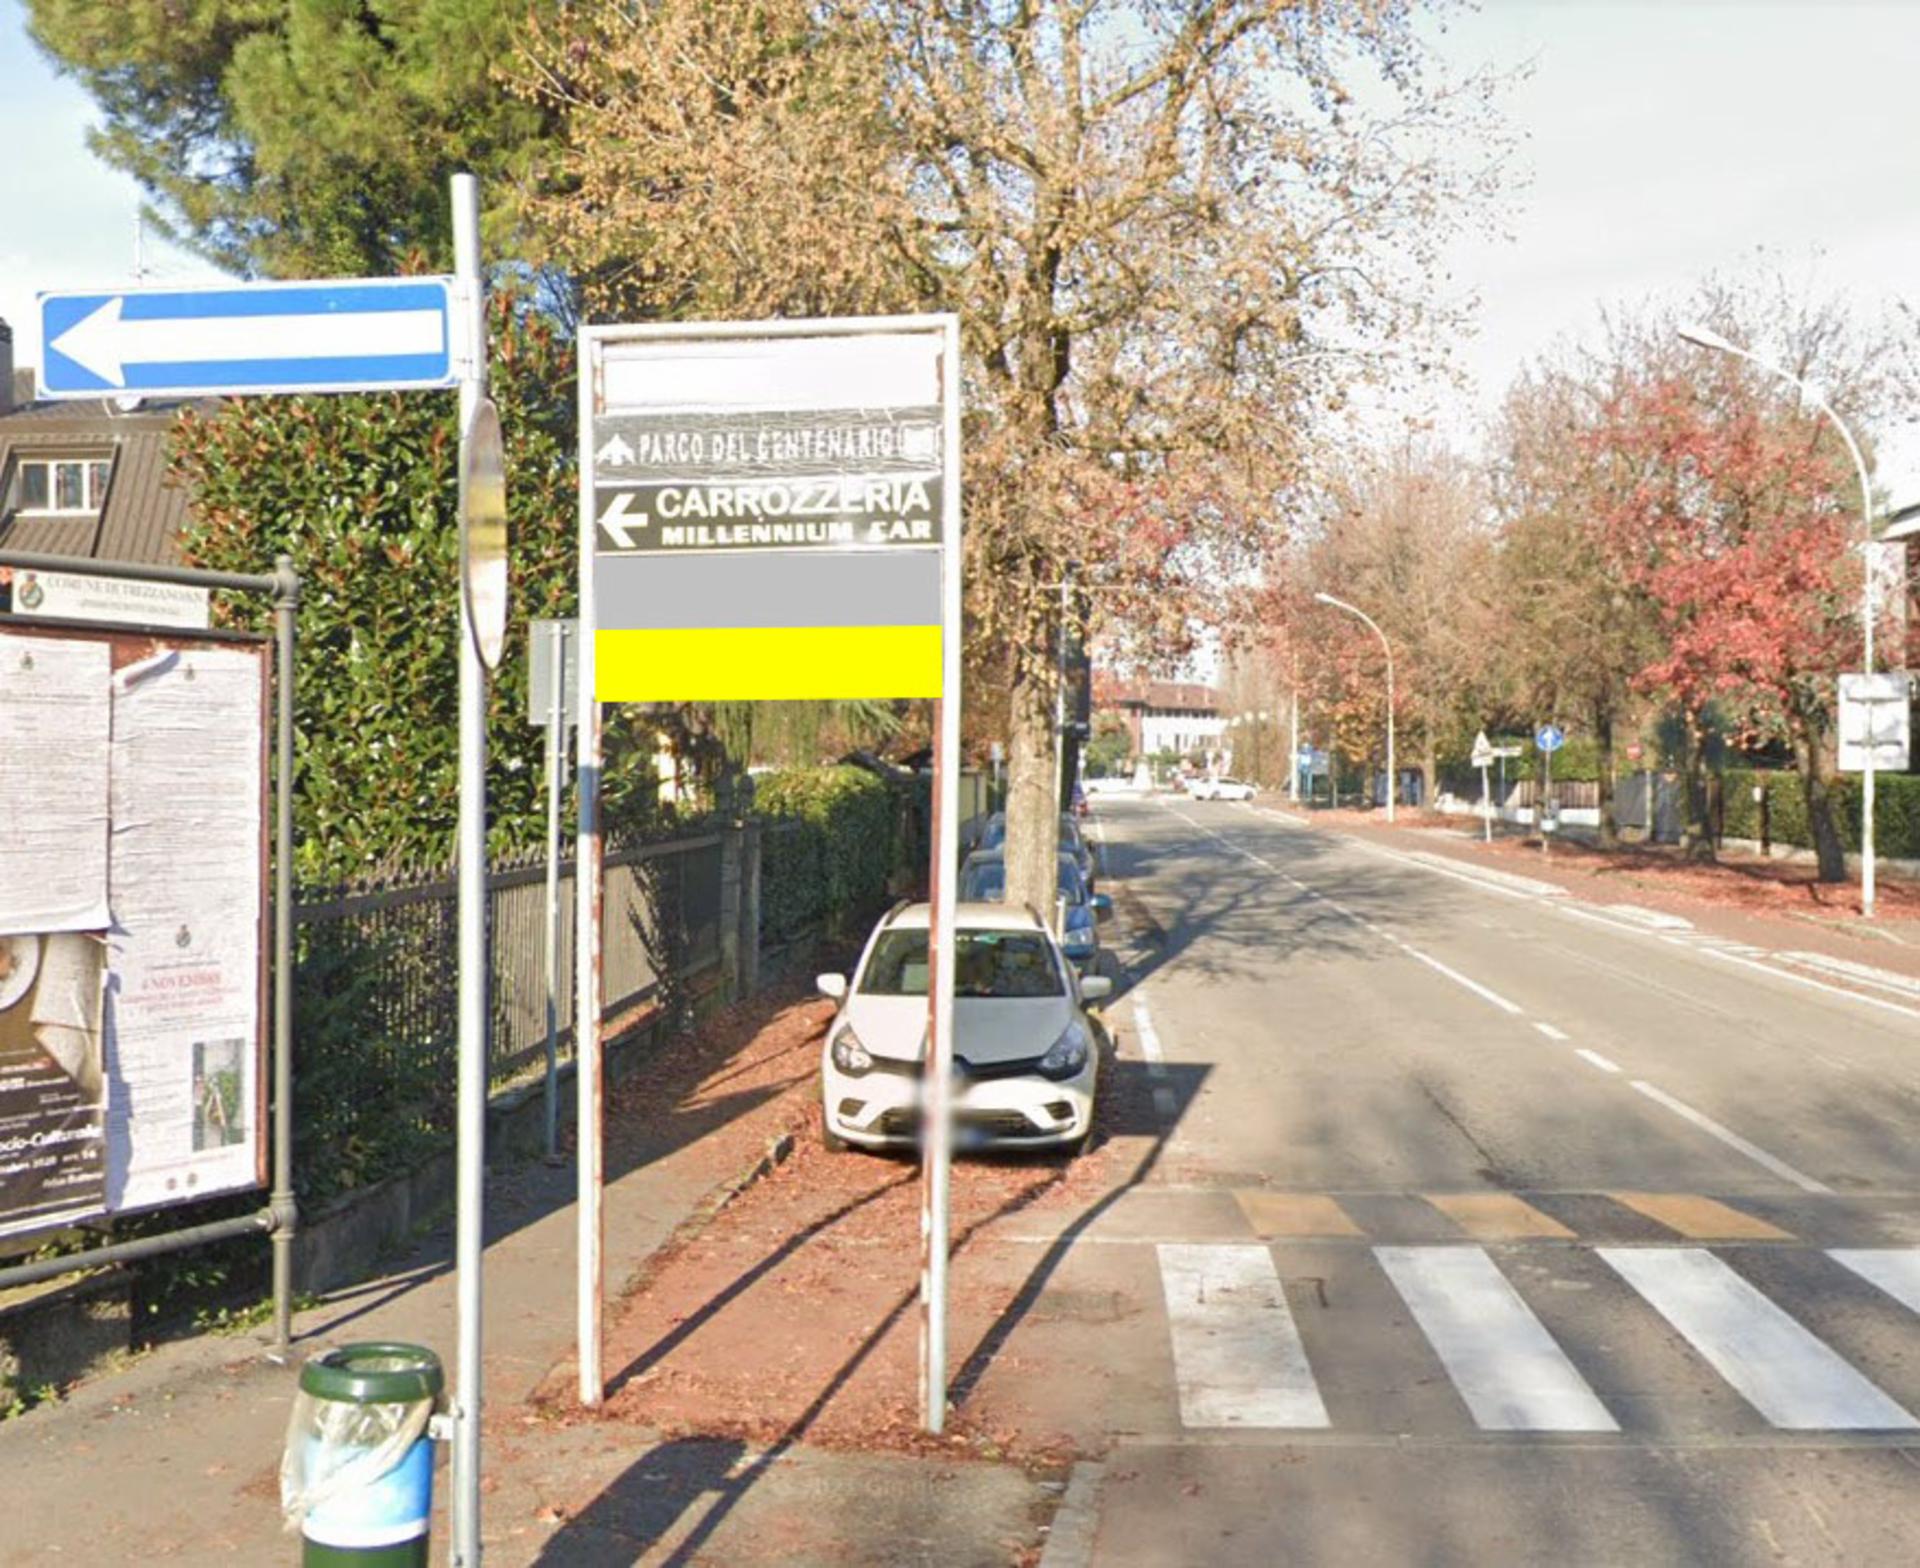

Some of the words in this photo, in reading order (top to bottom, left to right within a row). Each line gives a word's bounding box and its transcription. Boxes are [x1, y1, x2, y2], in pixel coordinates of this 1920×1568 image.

[639, 432, 704, 464] PARCO
[711, 432, 749, 462] DEL
[757, 427, 892, 463] CENTENARIO
[656, 480, 932, 519] CARROZZERIA
[661, 521, 854, 546] MILLENNIUM
